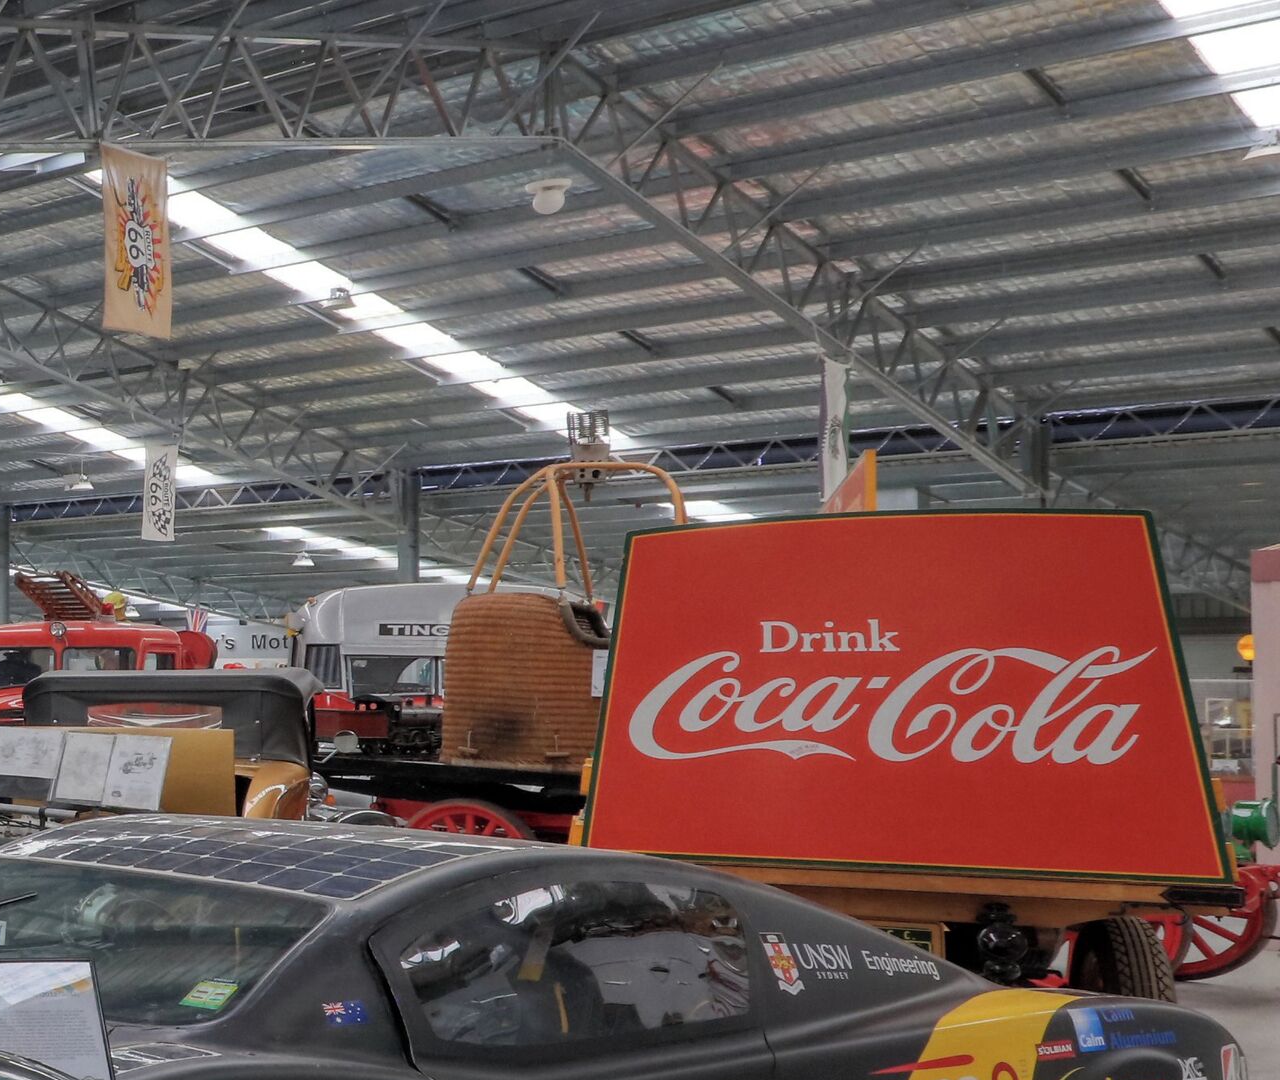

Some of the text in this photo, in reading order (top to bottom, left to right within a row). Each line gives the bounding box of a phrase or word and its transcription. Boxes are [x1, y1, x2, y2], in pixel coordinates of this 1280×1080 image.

[128, 227, 145, 260] 66
[150, 482, 162, 506] 66
[759, 619, 901, 653] Drink
[628, 645, 1158, 766] Coca-Cola
[792, 943, 941, 981] UNSW Engineering
[817, 971, 850, 980] SYDNEY
[1101, 1007, 1135, 1023] Calm
[1080, 1034, 1105, 1049] Calm
[1110, 1029, 1176, 1049] Aluminium
